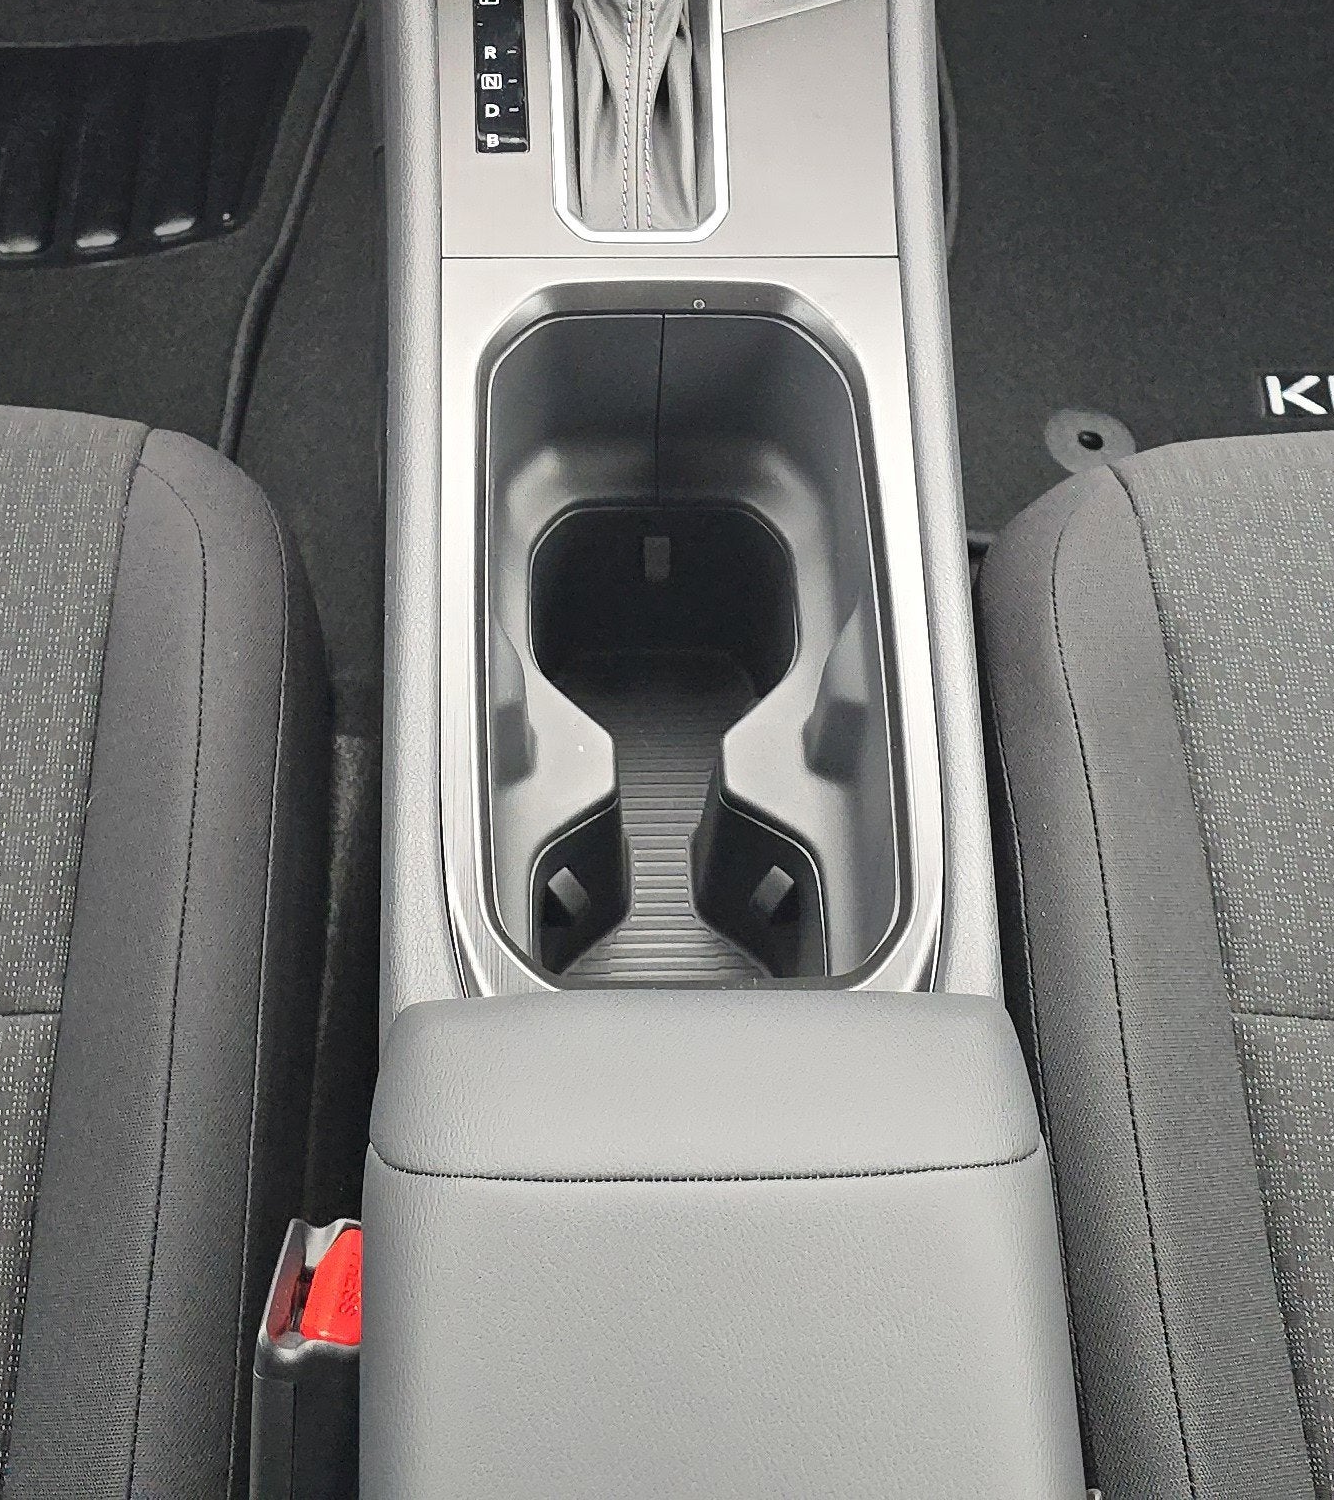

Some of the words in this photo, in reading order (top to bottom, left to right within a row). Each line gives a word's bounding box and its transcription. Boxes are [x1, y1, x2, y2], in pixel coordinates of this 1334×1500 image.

[484, 45, 497, 59] R
[485, 76, 498, 88] N
[485, 104, 499, 118] D
[486, 134, 499, 148] B
